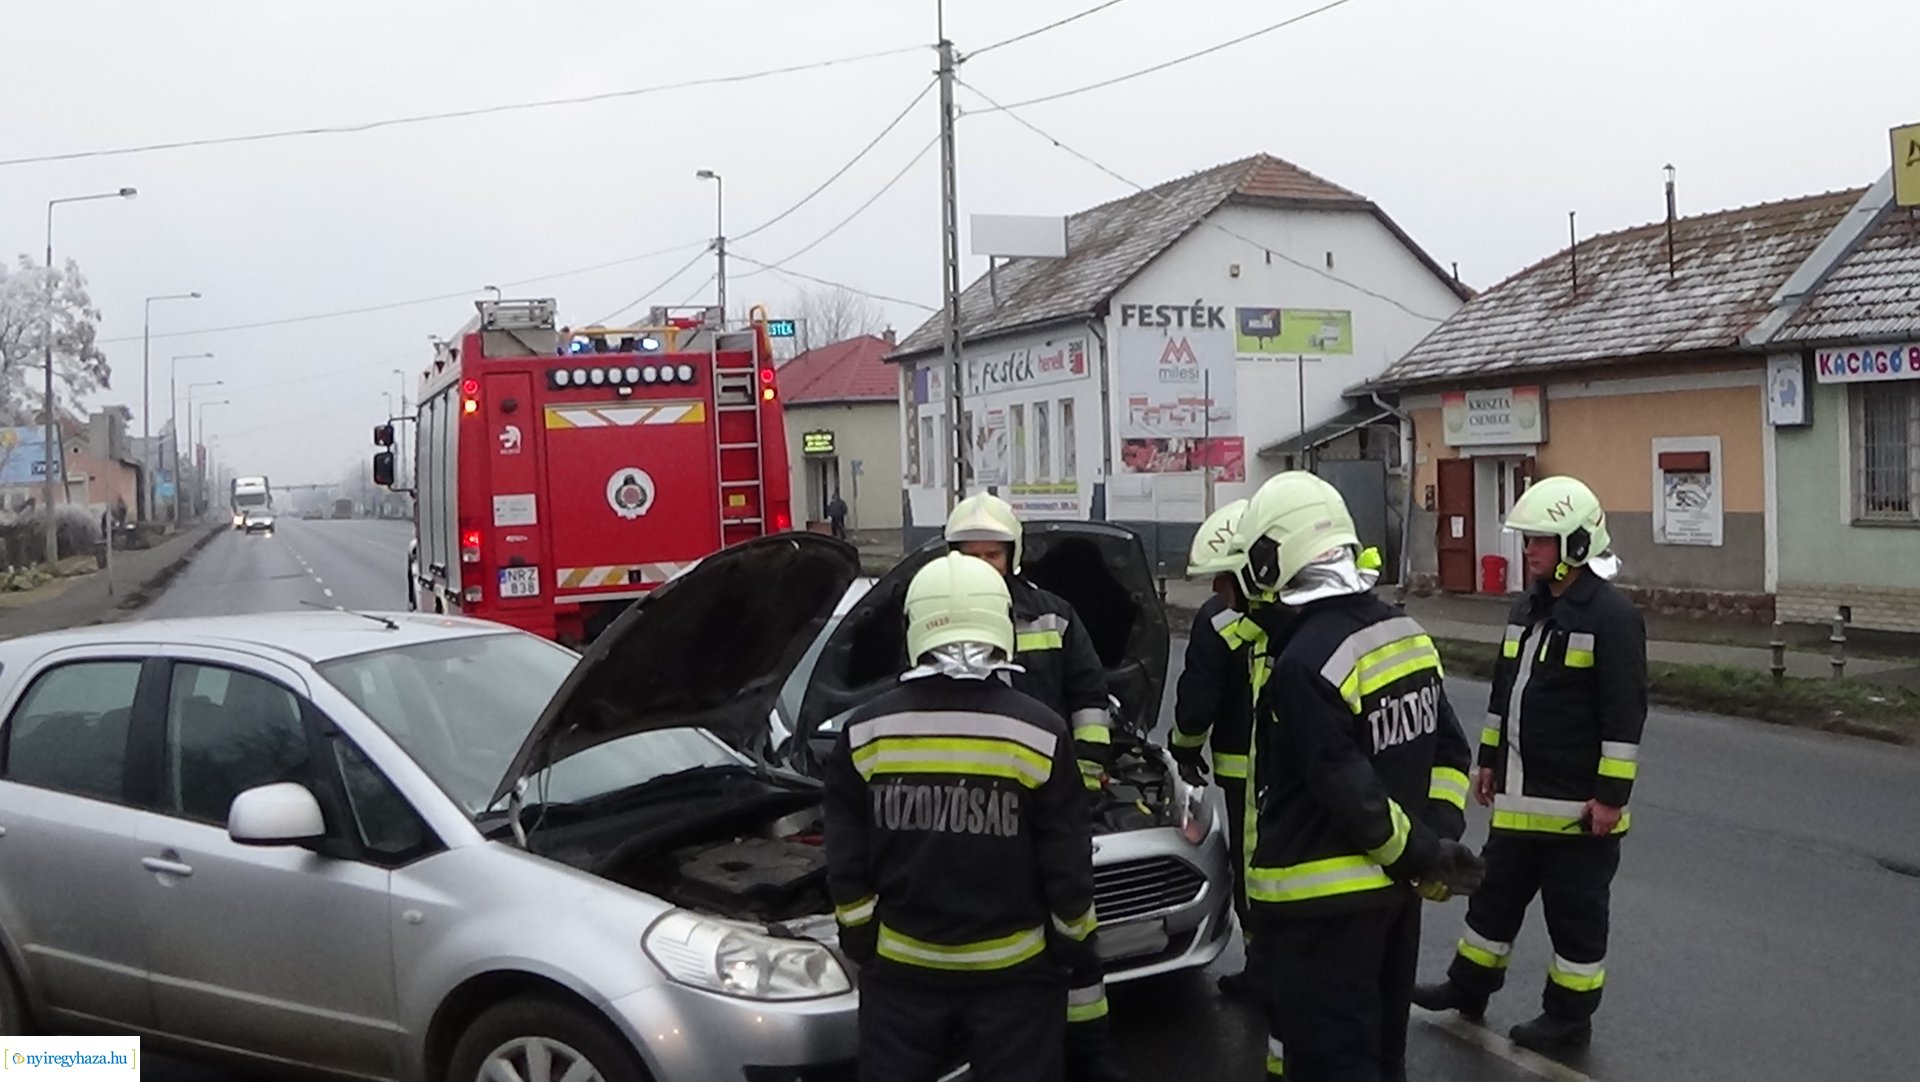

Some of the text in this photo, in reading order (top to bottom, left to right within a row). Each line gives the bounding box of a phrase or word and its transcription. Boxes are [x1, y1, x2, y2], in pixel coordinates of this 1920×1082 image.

[1121, 298, 1226, 329] FESTÉK
[1819, 344, 1904, 376] KACAGÓ
[1546, 495, 1575, 522] NY
[1208, 519, 1235, 553] NY
[508, 568, 536, 582] NRZ
[511, 581, 536, 594] 838
